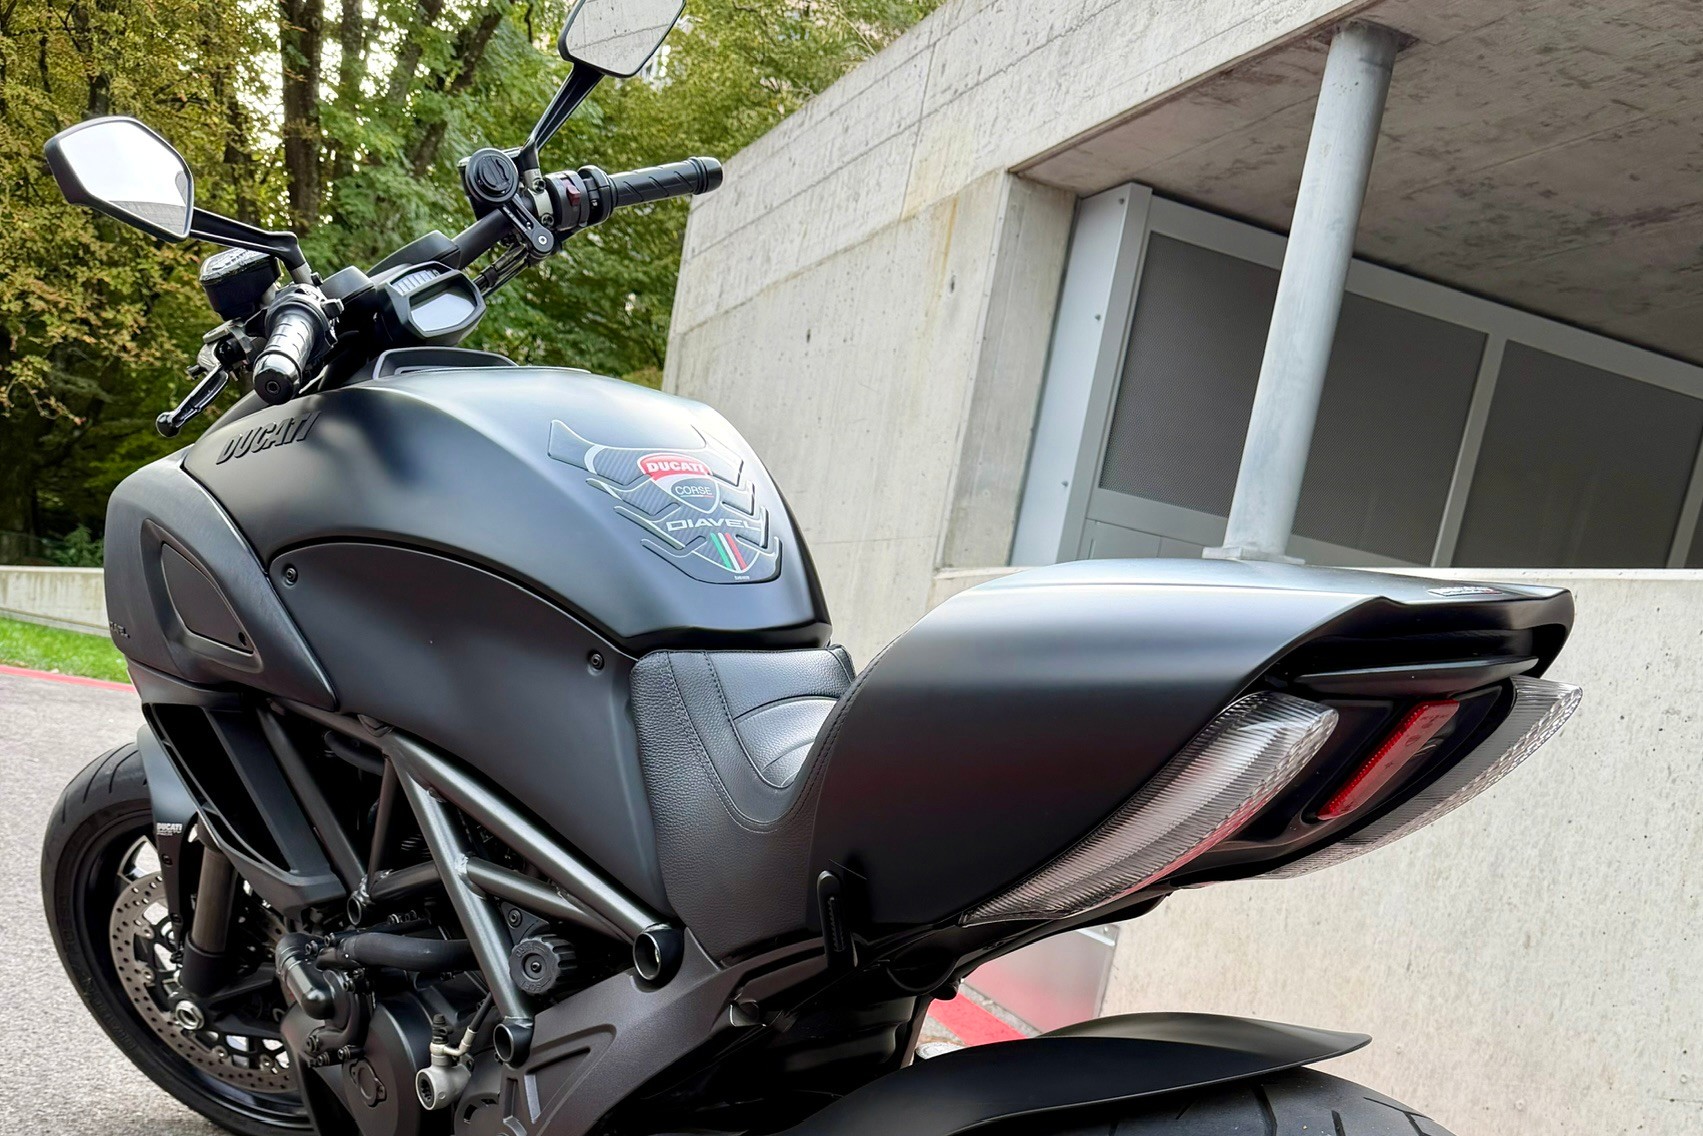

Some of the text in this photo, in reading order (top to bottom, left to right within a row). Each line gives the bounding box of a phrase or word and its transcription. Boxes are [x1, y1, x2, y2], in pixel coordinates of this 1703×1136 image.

[216, 410, 320, 465] DUCATI
[646, 461, 704, 473] DUCATI
[674, 485, 713, 495] CORSE
[665, 518, 762, 531] DIAVEL
